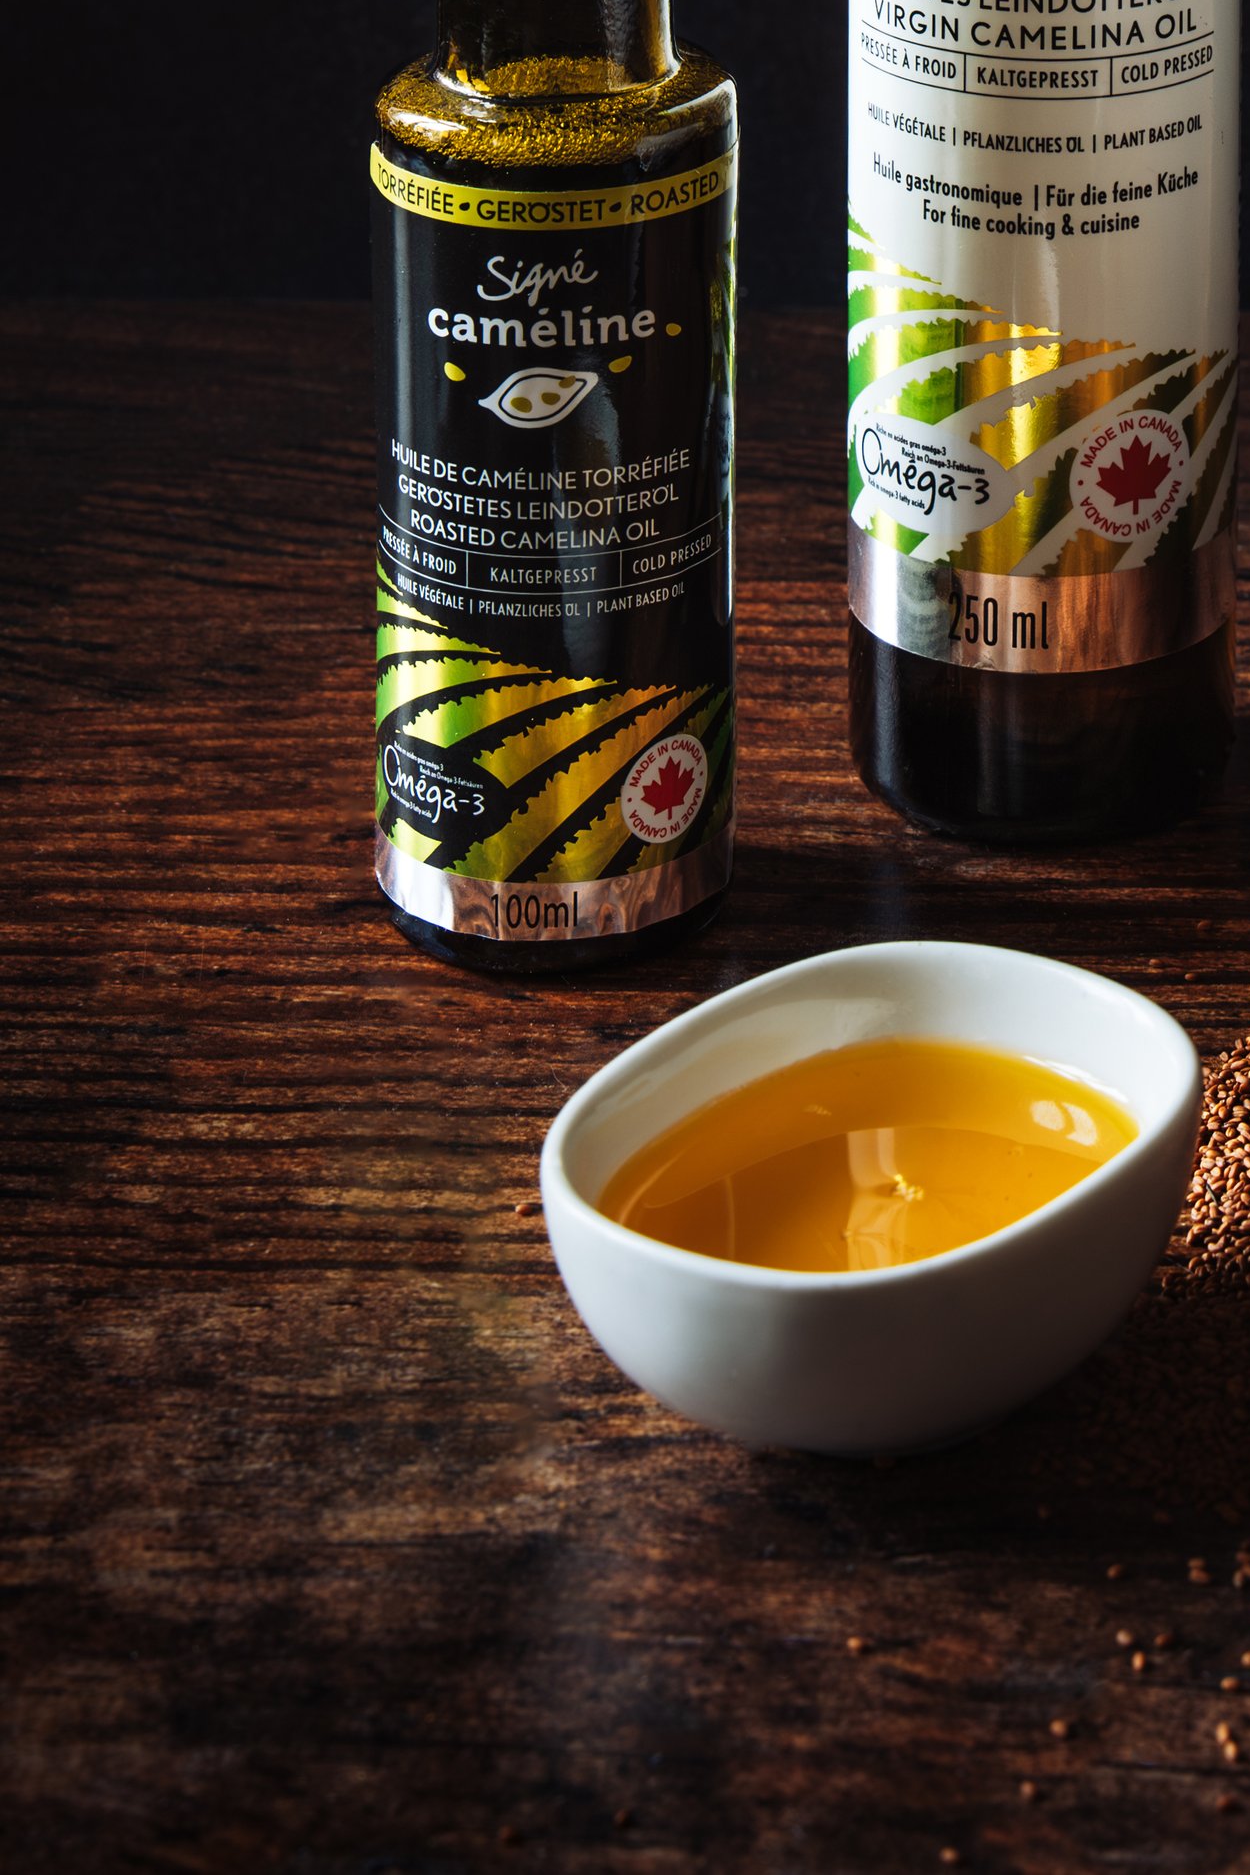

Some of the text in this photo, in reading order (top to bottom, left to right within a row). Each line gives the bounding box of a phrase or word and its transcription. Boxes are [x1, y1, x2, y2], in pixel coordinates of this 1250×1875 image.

[971, 20, 1145, 50] CAMELINA
[1155, 8, 1197, 39] OIL
[861, 32, 957, 80] PRESSÉE À FROID
[977, 66, 1099, 89] KALTGEPRESST
[1121, 44, 1213, 84] COLD PRESSED
[867, 101, 1203, 153] HUILE VÉGÉTALE PFLANZLICHES ÖL PLANT BASED OIL
[377, 162, 719, 223] TORRÉFIÉE GERÖSTET ROASTED
[873, 151, 1199, 209] Huile gastronomique Für die feine Küche
[923, 199, 1140, 241] For fine cooking & cuisine
[476, 249, 599, 307] Signé
[427, 305, 656, 348] caméline
[391, 438, 691, 491] HUILE DE CAMÉLINE TORRÉFIÉE
[909, 440, 921, 451] gras
[1080, 416, 1182, 468] MADE IN CANADA
[862, 427, 990, 516] Oméga-3
[398, 473, 680, 520] GERÖSTETES LEINDOTTERÖL
[1080, 480, 1182, 537] MADE IN CANADA
[382, 525, 457, 575] PRESSÉE À FROID
[410, 508, 660, 550] ROASTED CAMELINA OIL
[490, 566, 597, 585] KALTGEPRESST
[632, 533, 712, 575] COLD PRESSED
[397, 572, 685, 618] HUILE VÉGÉTALE PFLANZLICHES ÖL PLANT BASED OIL
[948, 591, 1050, 650] 250 ml
[384, 744, 485, 824] Oméga-3
[629, 739, 703, 788] MADE IN CANADA
[628, 787, 703, 839] MADE IN CANADA
[490, 890, 579, 931] 100ml
